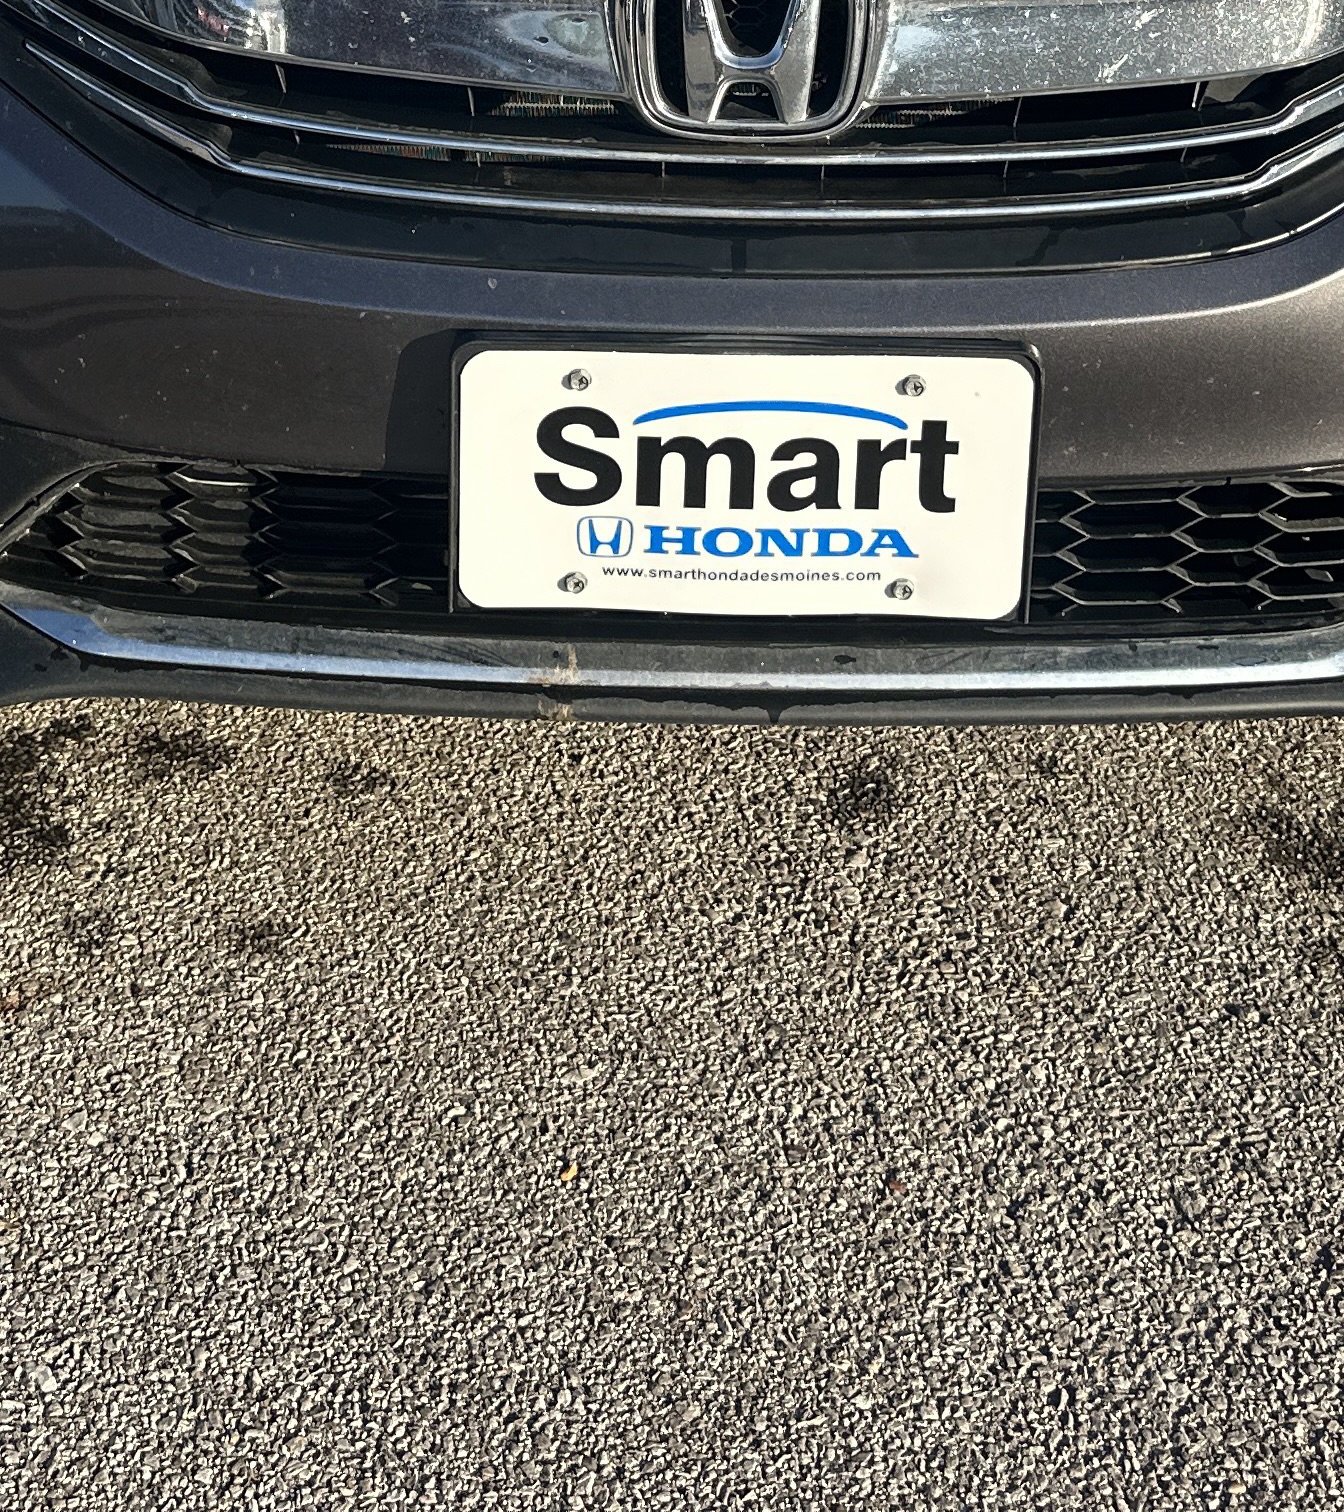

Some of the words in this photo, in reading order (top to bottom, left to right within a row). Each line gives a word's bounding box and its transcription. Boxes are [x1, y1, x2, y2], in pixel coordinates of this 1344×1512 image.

[534, 406, 960, 513] Smart
[643, 524, 920, 558] HONDA
[601, 564, 882, 583] www.smarthondadesmoines.com
